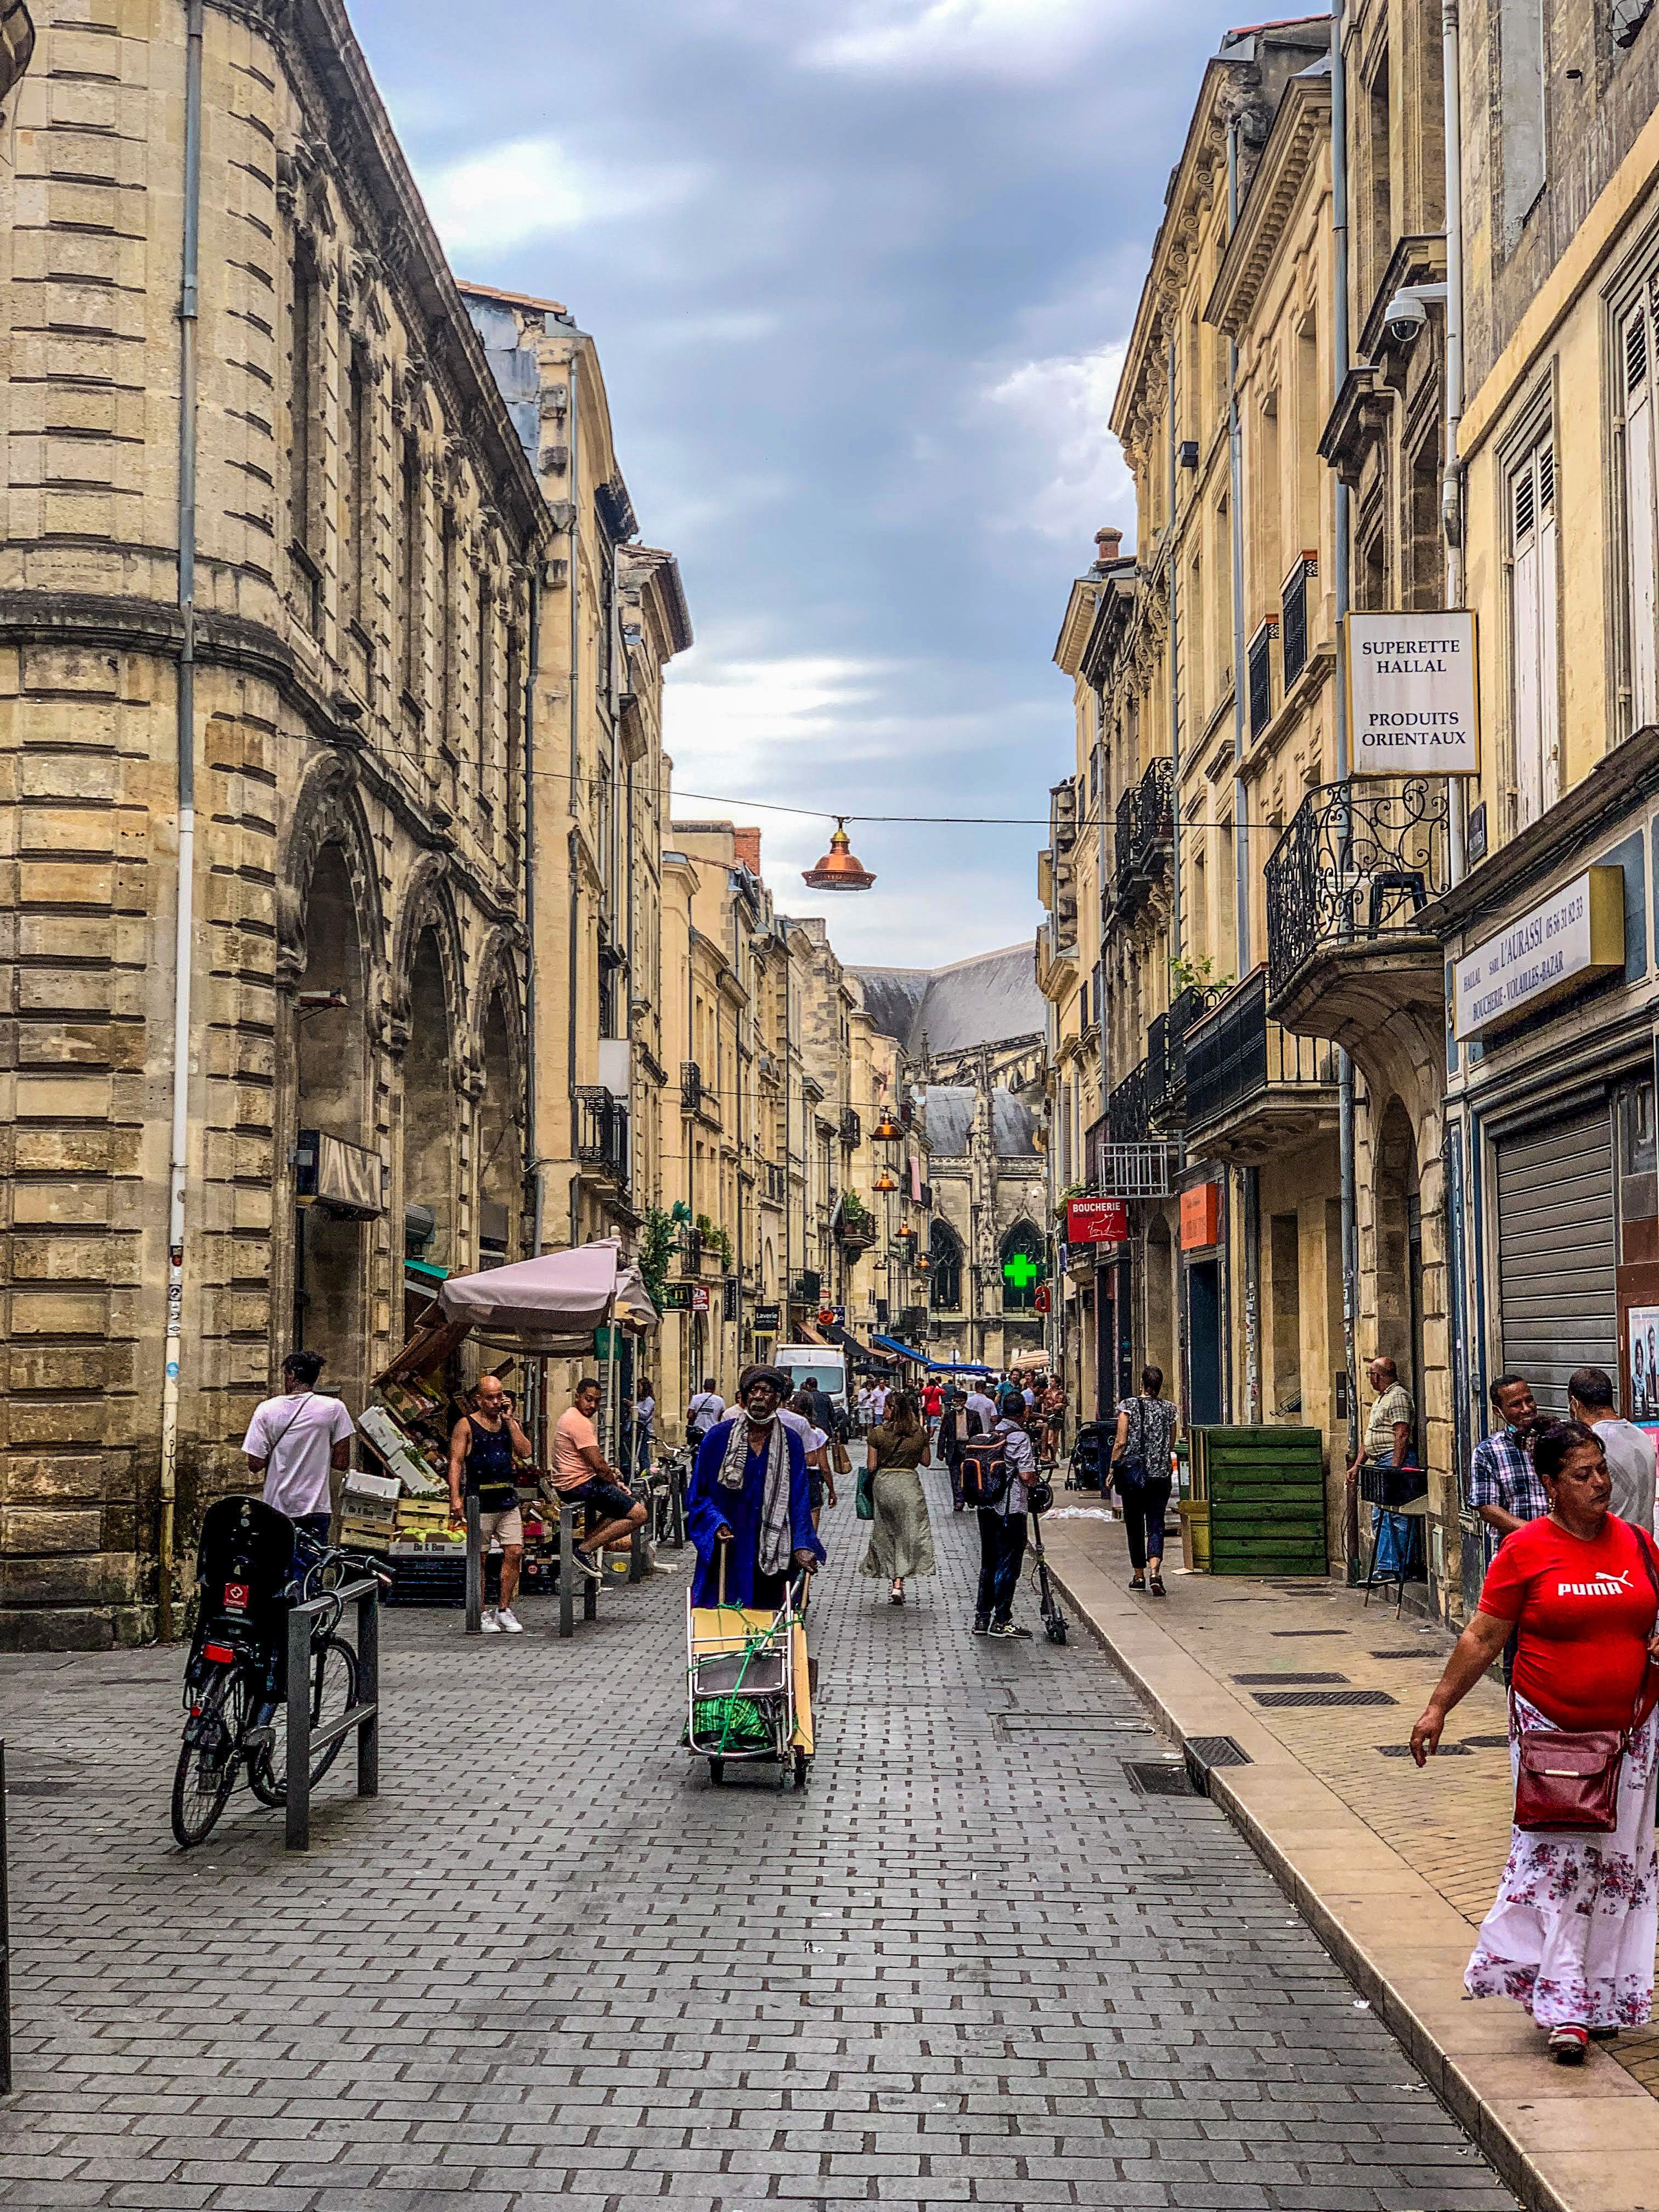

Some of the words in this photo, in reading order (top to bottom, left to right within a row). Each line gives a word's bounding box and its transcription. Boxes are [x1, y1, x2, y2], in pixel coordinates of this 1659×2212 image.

[1362, 640, 1460, 655] SUPERETTE
[1376, 659, 1447, 673] HALLAL
[1369, 712, 1459, 726] PRODUITS
[1362, 731, 1466, 746] ORIENTAUX
[1500, 917, 1543, 967] L'AURASSI
[1576, 895, 1583, 919] 33
[1473, 986, 1503, 1021] BOUCHERIE
[1073, 1202, 1121, 1213] BOUCHERIE
[1558, 1582, 1623, 1596] PUMA
